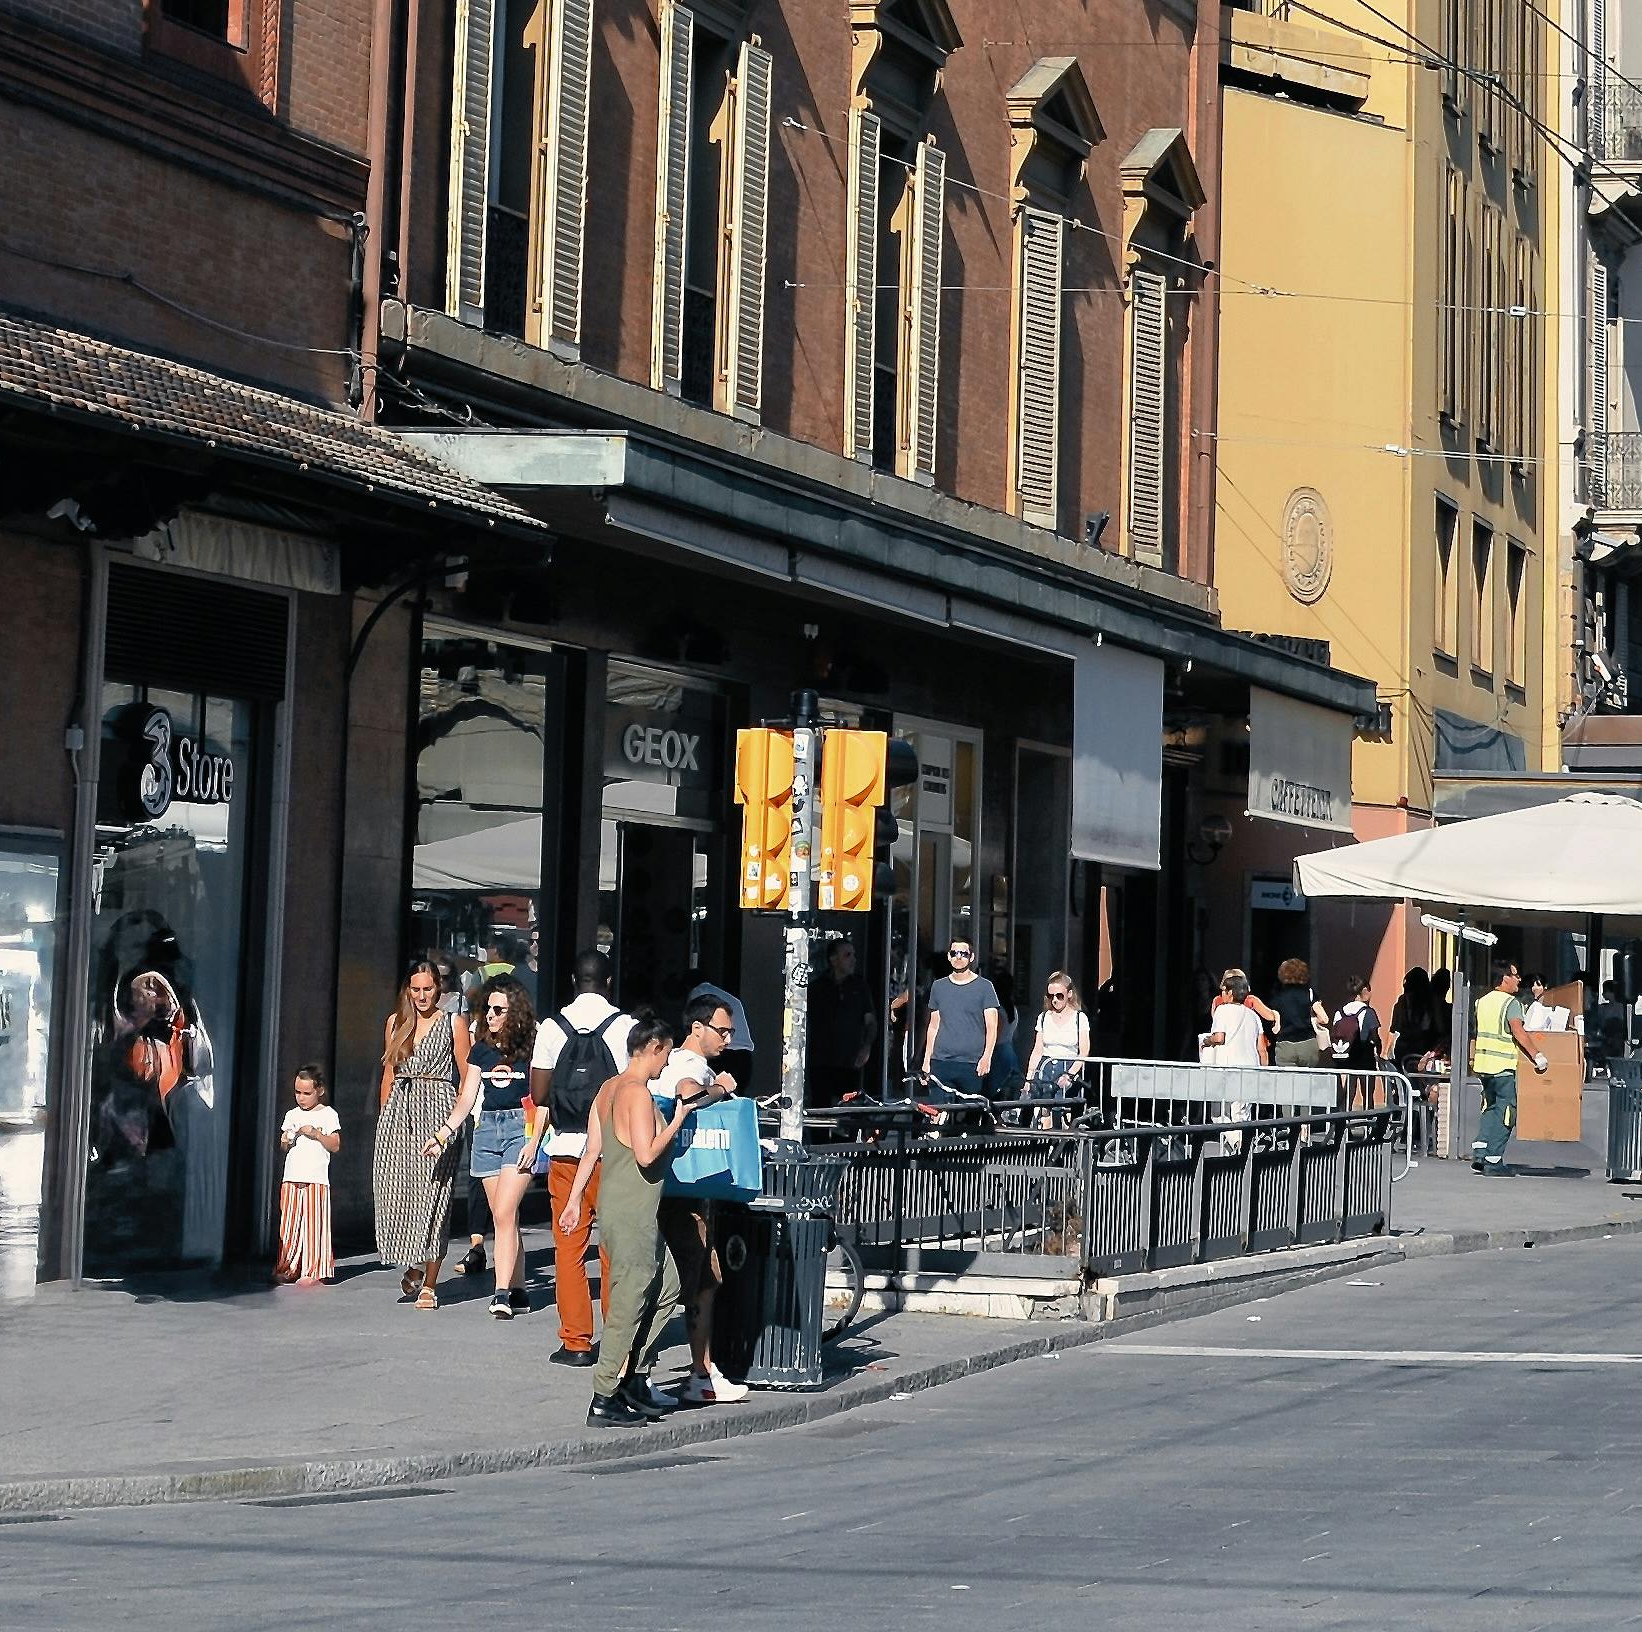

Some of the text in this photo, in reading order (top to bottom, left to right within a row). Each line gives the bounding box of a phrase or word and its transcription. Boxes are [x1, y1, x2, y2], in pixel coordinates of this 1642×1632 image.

[141, 710, 234, 815] 3 Store
[623, 723, 700, 771] GEOX
